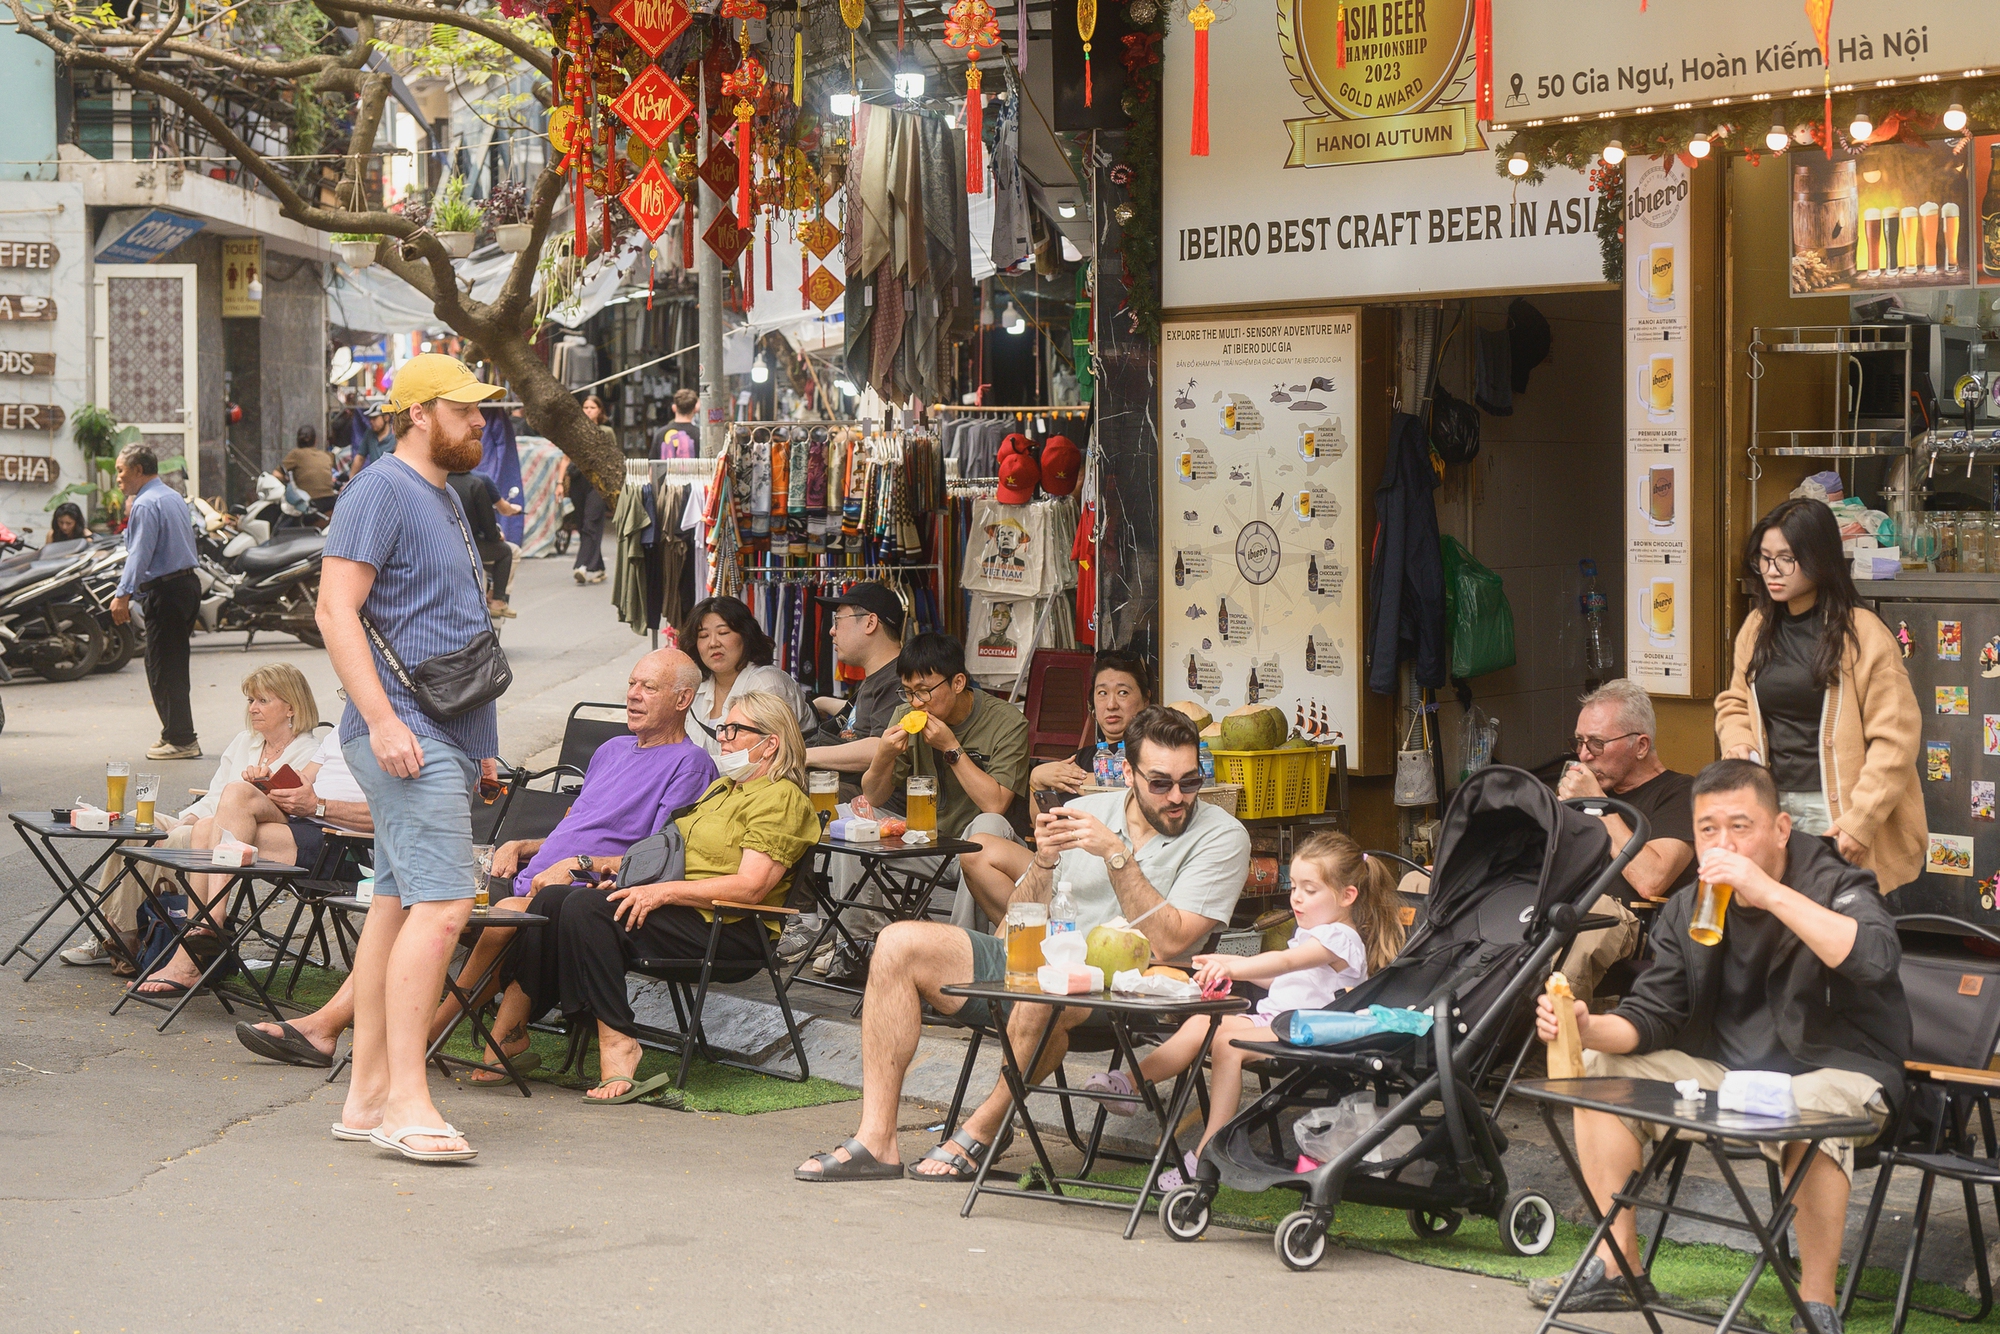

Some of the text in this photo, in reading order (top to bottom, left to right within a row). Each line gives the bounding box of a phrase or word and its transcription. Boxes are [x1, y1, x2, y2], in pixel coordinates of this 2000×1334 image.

[1382, 0, 1427, 37] BEER
[1345, 37, 1428, 62] HAMPIONSHIP
[1365, 61, 1401, 83] 2023
[1537, 73, 1565, 99] 50
[1571, 69, 1609, 96] Gia
[1617, 62, 1675, 95] Ngư,
[1682, 52, 1747, 83] Hoàn
[1837, 34, 1874, 63] Hà
[1882, 25, 1929, 62] Nội
[1339, 77, 1424, 109] GOLD AWARD
[1316, 125, 1453, 152] HANOI AUTUMN
[1179, 221, 1261, 262] IBEIRO
[1266, 216, 1332, 255] BEST
[1336, 210, 1422, 250] CRAFT
[1428, 204, 1503, 244] BEER
[1509, 201, 1538, 239] IN
[225, 244, 259, 256] TOILET
[1166, 330, 1201, 341] EXPLORE
[1202, 329, 1217, 340] THE
[1218, 327, 1241, 339] MULTI
[1246, 326, 1282, 338] SENSORY
[1283, 324, 1332, 336] ADVENTURE
[1333, 323, 1352, 335] MAP
[1222, 341, 1292, 355] AT IBIERO DUC GIA
[2, 404, 41, 430] ER
[1001, 569, 1022, 579] NAM
[383, 648, 399, 670] adidas
[979, 648, 1016, 657] ROCKETMAN
